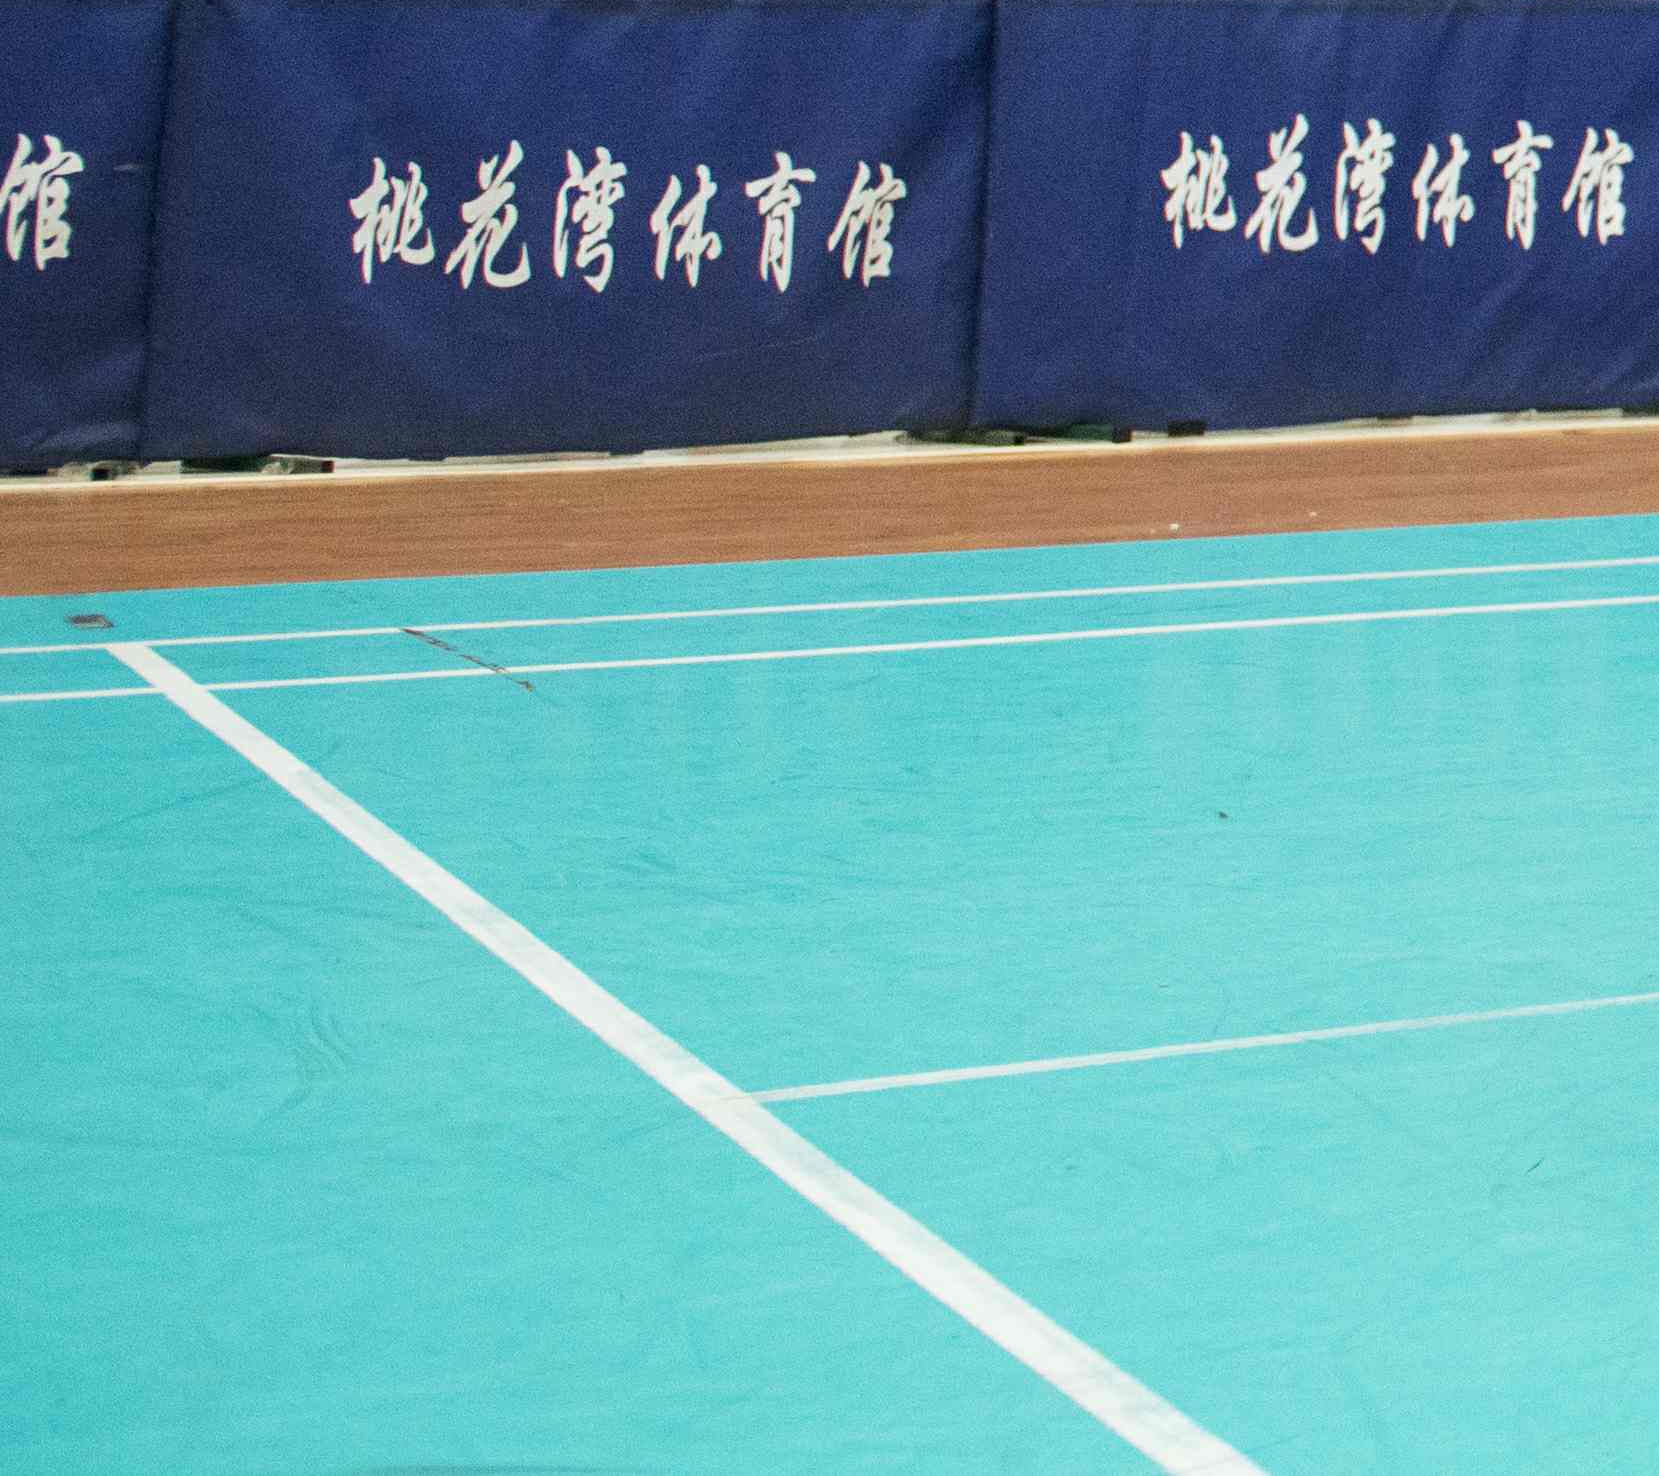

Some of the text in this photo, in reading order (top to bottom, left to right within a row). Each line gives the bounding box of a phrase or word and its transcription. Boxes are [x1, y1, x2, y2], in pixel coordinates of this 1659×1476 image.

[348, 139, 908, 293] 桃花湾体育馆
[1160, 113, 1636, 254] 桃花湾体育馆
